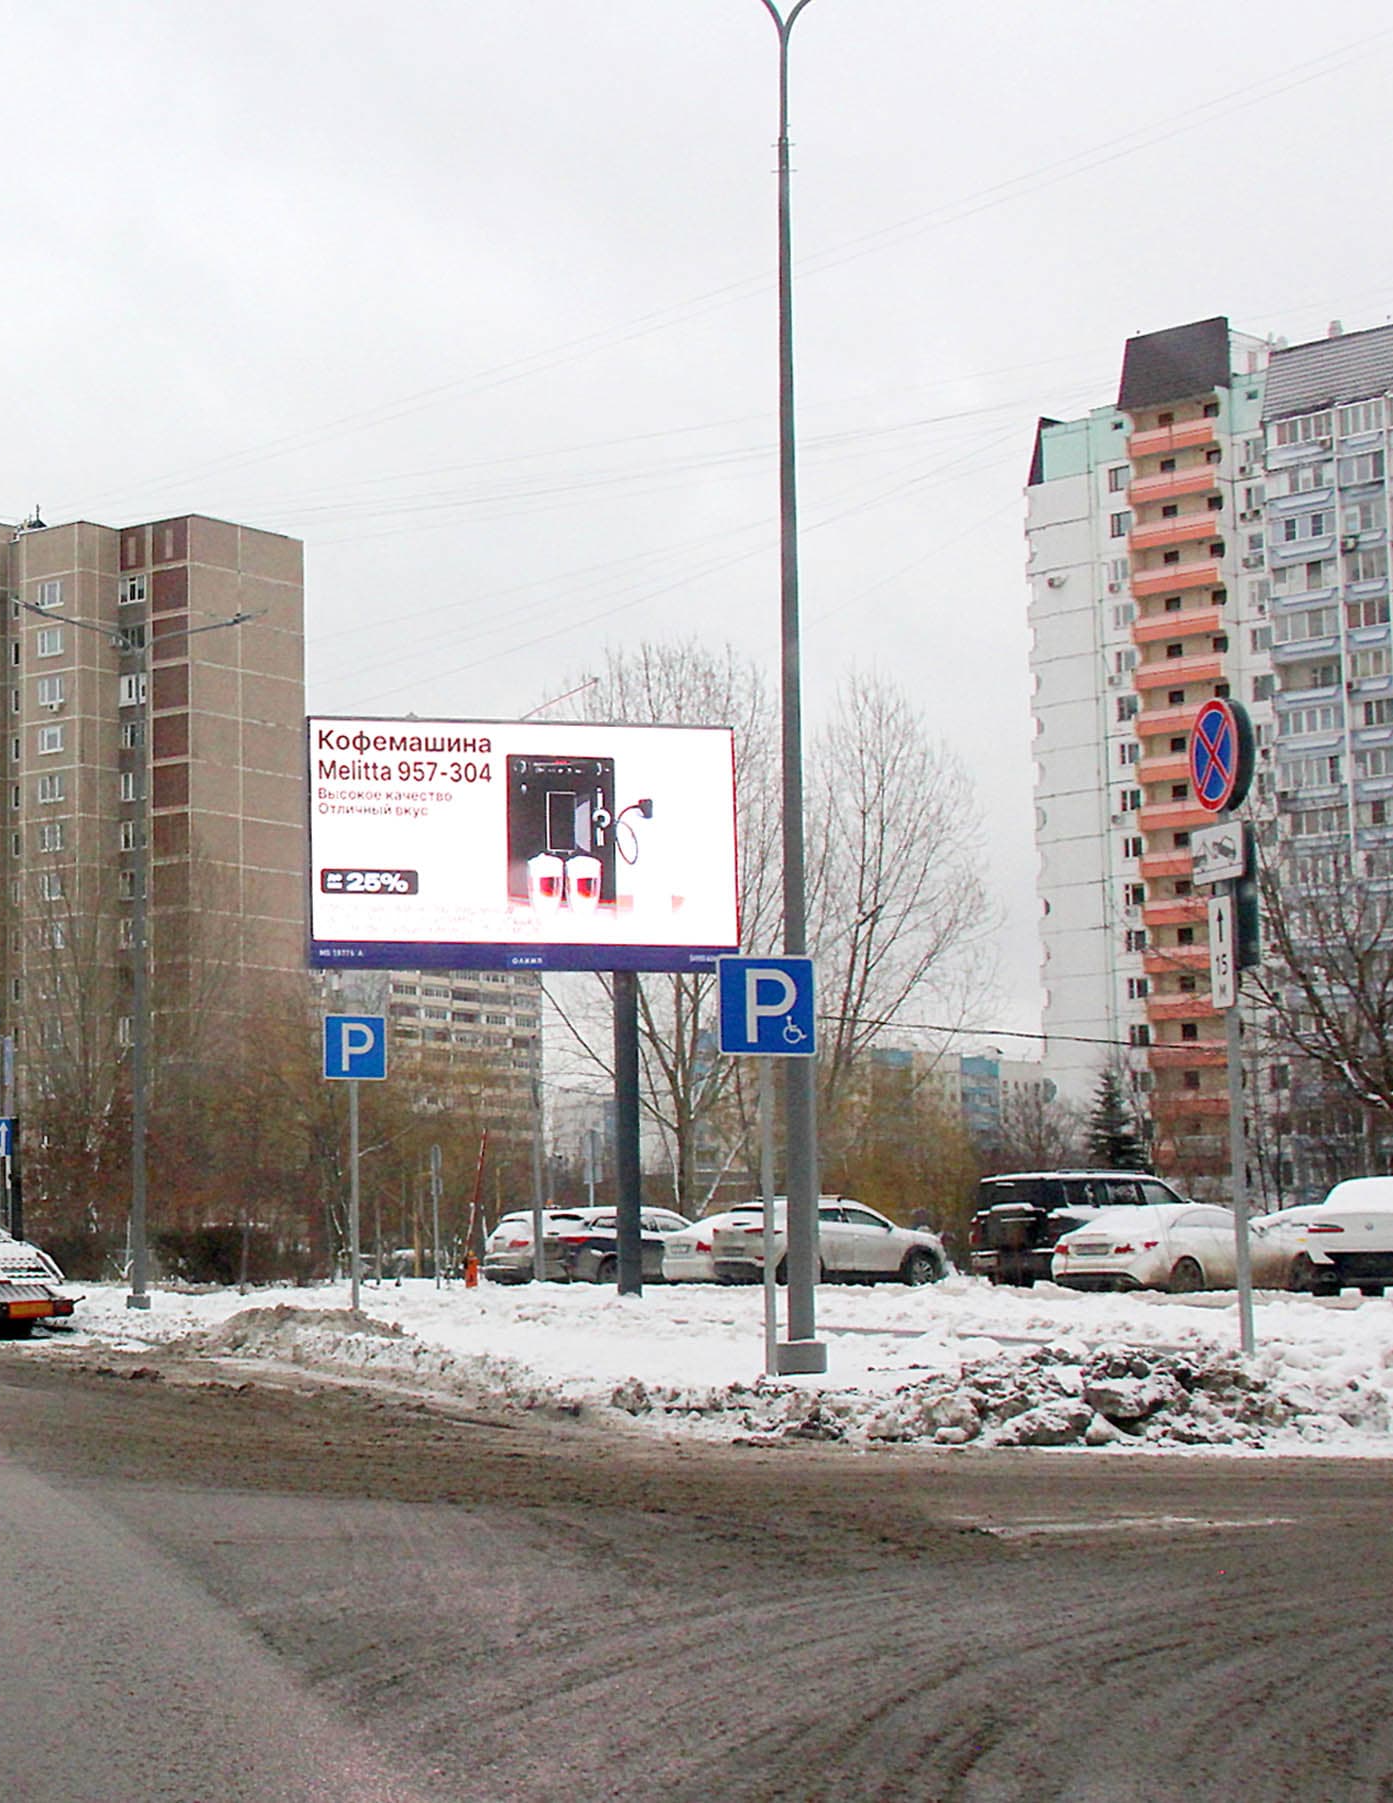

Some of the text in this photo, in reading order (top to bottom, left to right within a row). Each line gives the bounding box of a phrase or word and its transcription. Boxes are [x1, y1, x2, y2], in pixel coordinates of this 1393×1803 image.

[318, 730, 492, 755] Кофемашина
[318, 759, 492, 783] Melitta 957-304
[318, 787, 453, 802] Высокое качество
[318, 803, 429, 818] Отличный вкус
[1215, 953, 1228, 976] 15
[745, 968, 797, 1043] P
[341, 1022, 375, 1072] P
